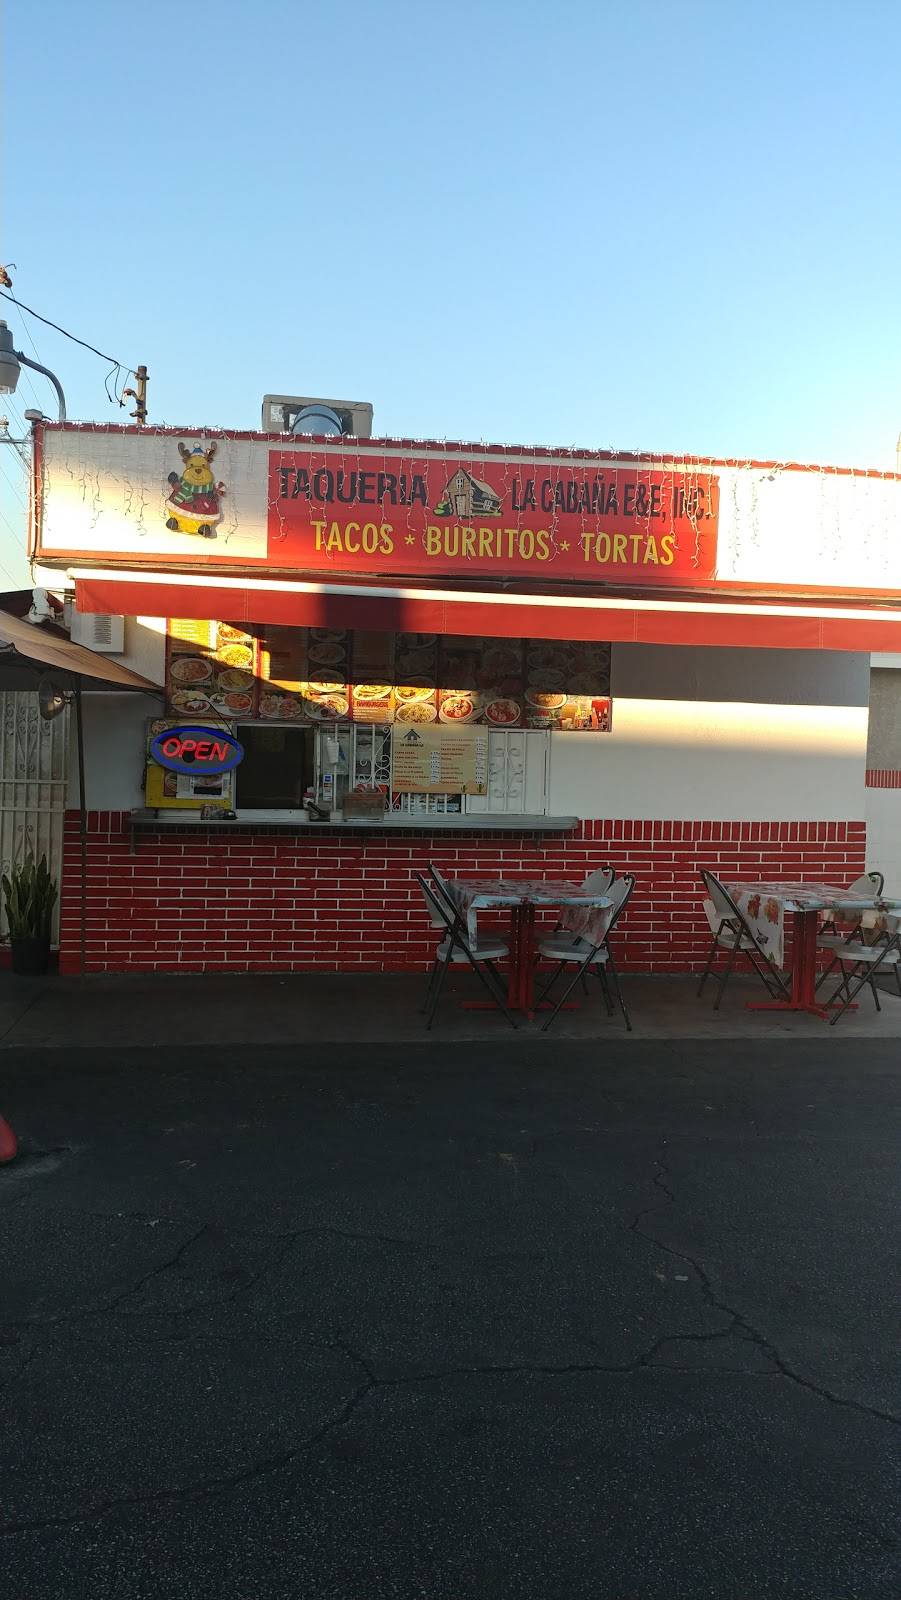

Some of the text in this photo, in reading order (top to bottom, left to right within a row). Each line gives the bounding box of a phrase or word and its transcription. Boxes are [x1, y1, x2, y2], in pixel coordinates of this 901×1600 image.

[276, 467, 429, 507] TAQUERIA
[511, 479, 536, 512] LA
[541, 475, 618, 515] CABAÑA
[310, 520, 394, 555] TACOS
[426, 526, 550, 561] BURRITOS
[582, 532, 675, 566] TORTAS
[162, 737, 230, 762] OPEN
